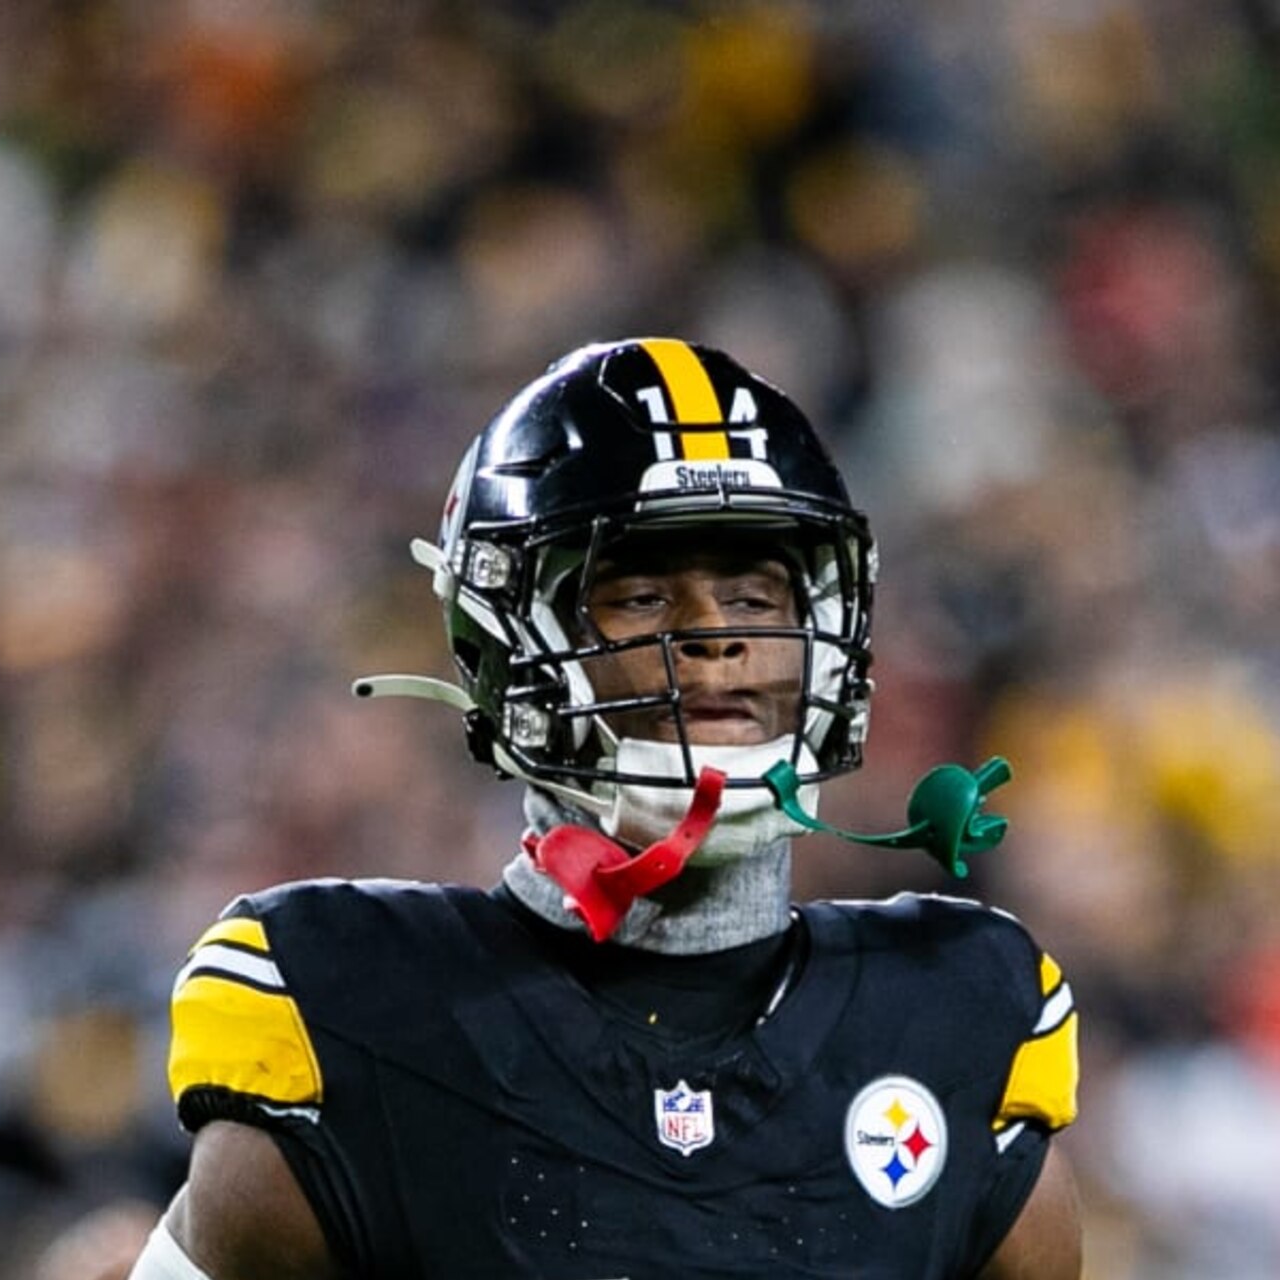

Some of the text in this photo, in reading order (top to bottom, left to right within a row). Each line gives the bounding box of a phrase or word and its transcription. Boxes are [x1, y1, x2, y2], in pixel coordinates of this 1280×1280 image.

[636, 385, 768, 460] 14
[675, 464, 750, 489] Steelers
[666, 1115, 704, 1141] NFL
